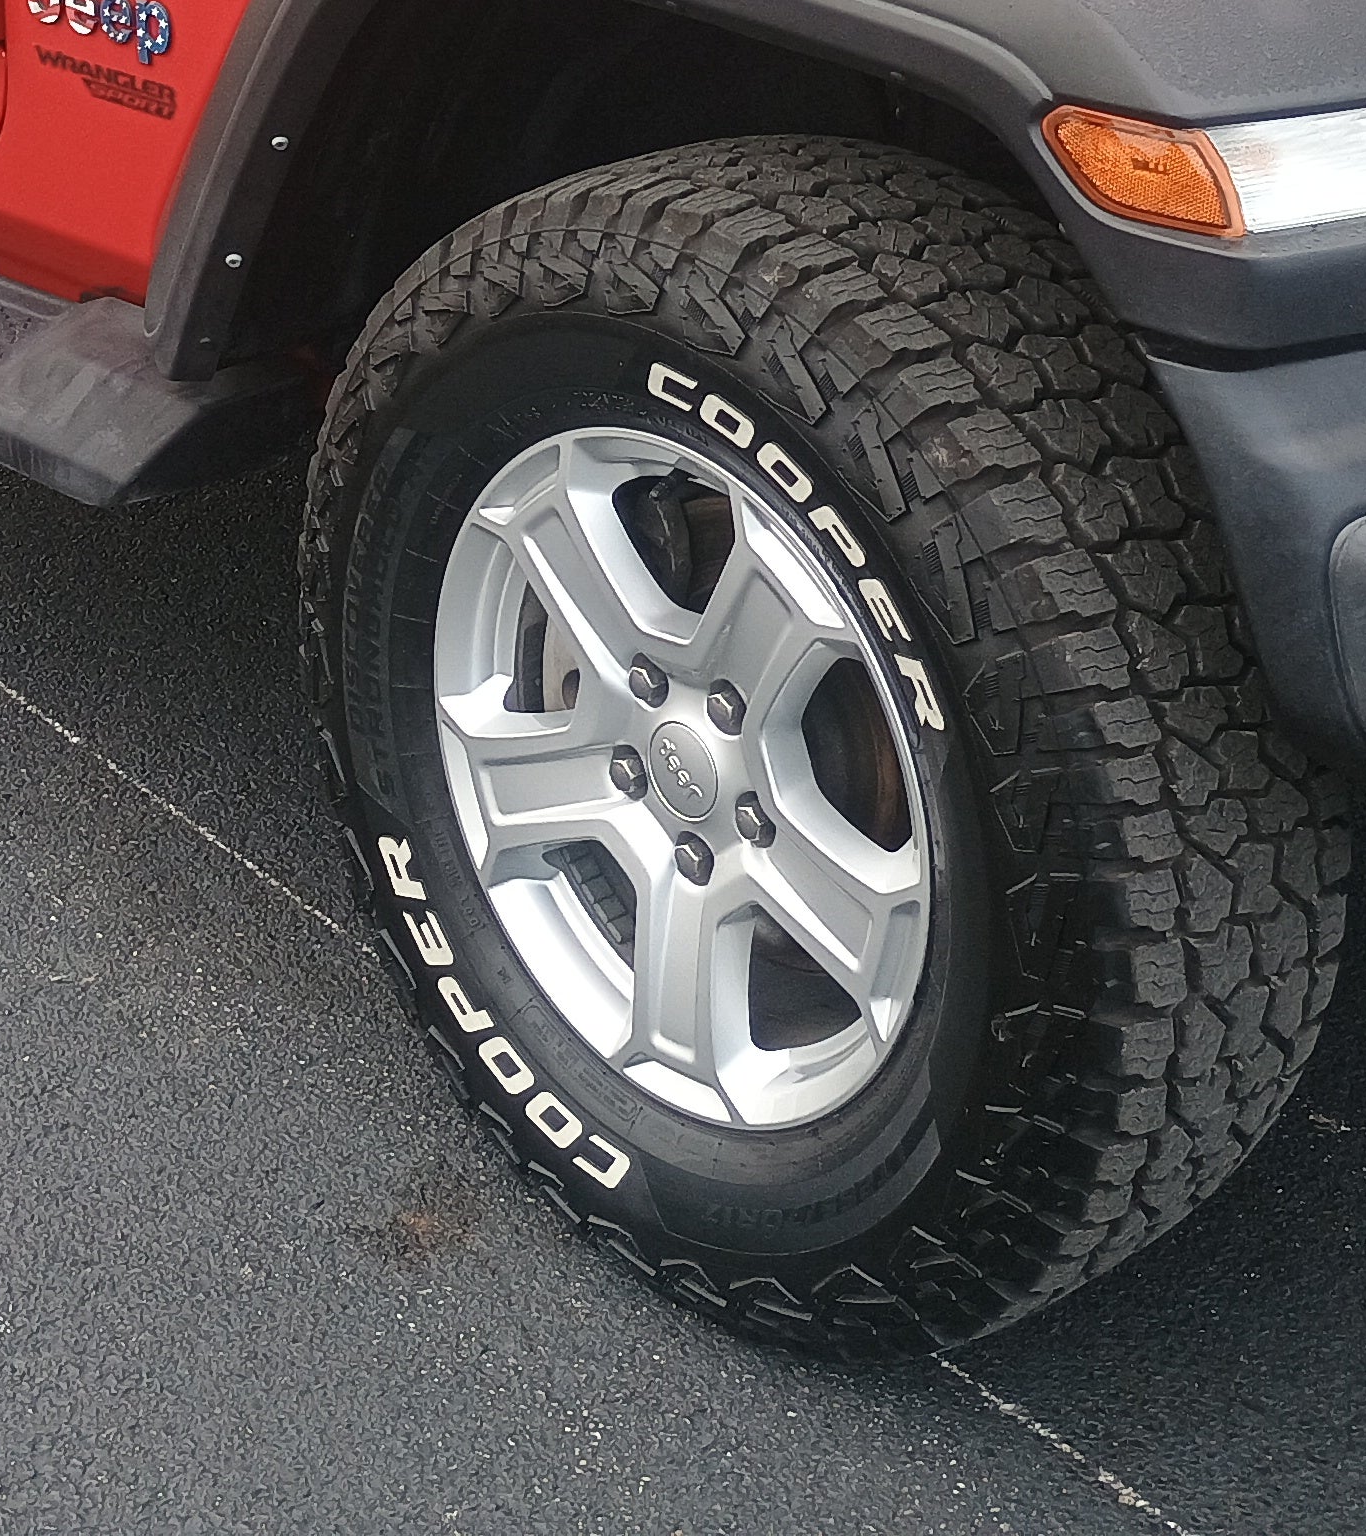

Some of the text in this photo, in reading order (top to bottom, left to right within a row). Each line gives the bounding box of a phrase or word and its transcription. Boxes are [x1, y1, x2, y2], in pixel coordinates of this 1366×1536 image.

[34, 44, 175, 98] WRANGLER
[647, 362, 946, 734] COOPER
[377, 832, 631, 1189] COOPER
